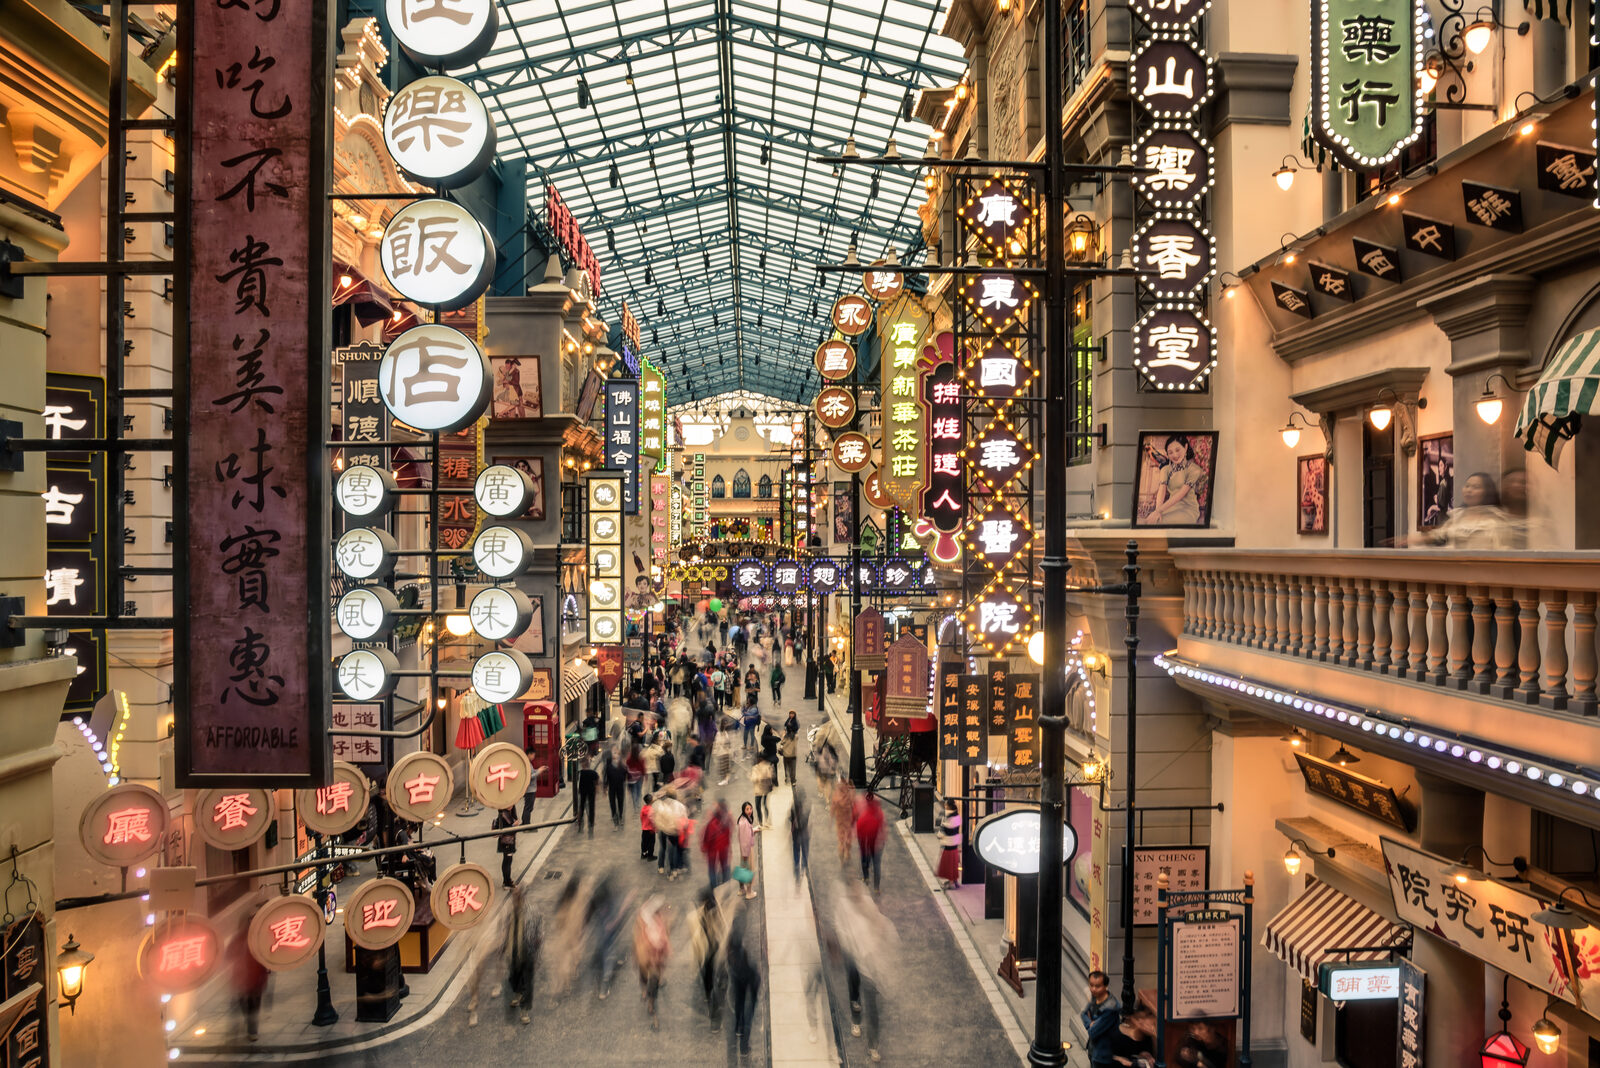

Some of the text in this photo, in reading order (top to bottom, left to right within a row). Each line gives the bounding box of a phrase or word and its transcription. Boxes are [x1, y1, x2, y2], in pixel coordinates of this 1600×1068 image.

[340, 351, 370, 361] SHUN
[891, 322, 918, 477] 廣東新華茶莊
[977, 194, 1020, 633] 廣東國華醫院
[338, 471, 377, 691] 傳統風味
[473, 471, 516, 694] 廣東味道
[206, 726, 298, 749] AFFORDABLE
[1135, 853, 1196, 863] XIN CHENG
